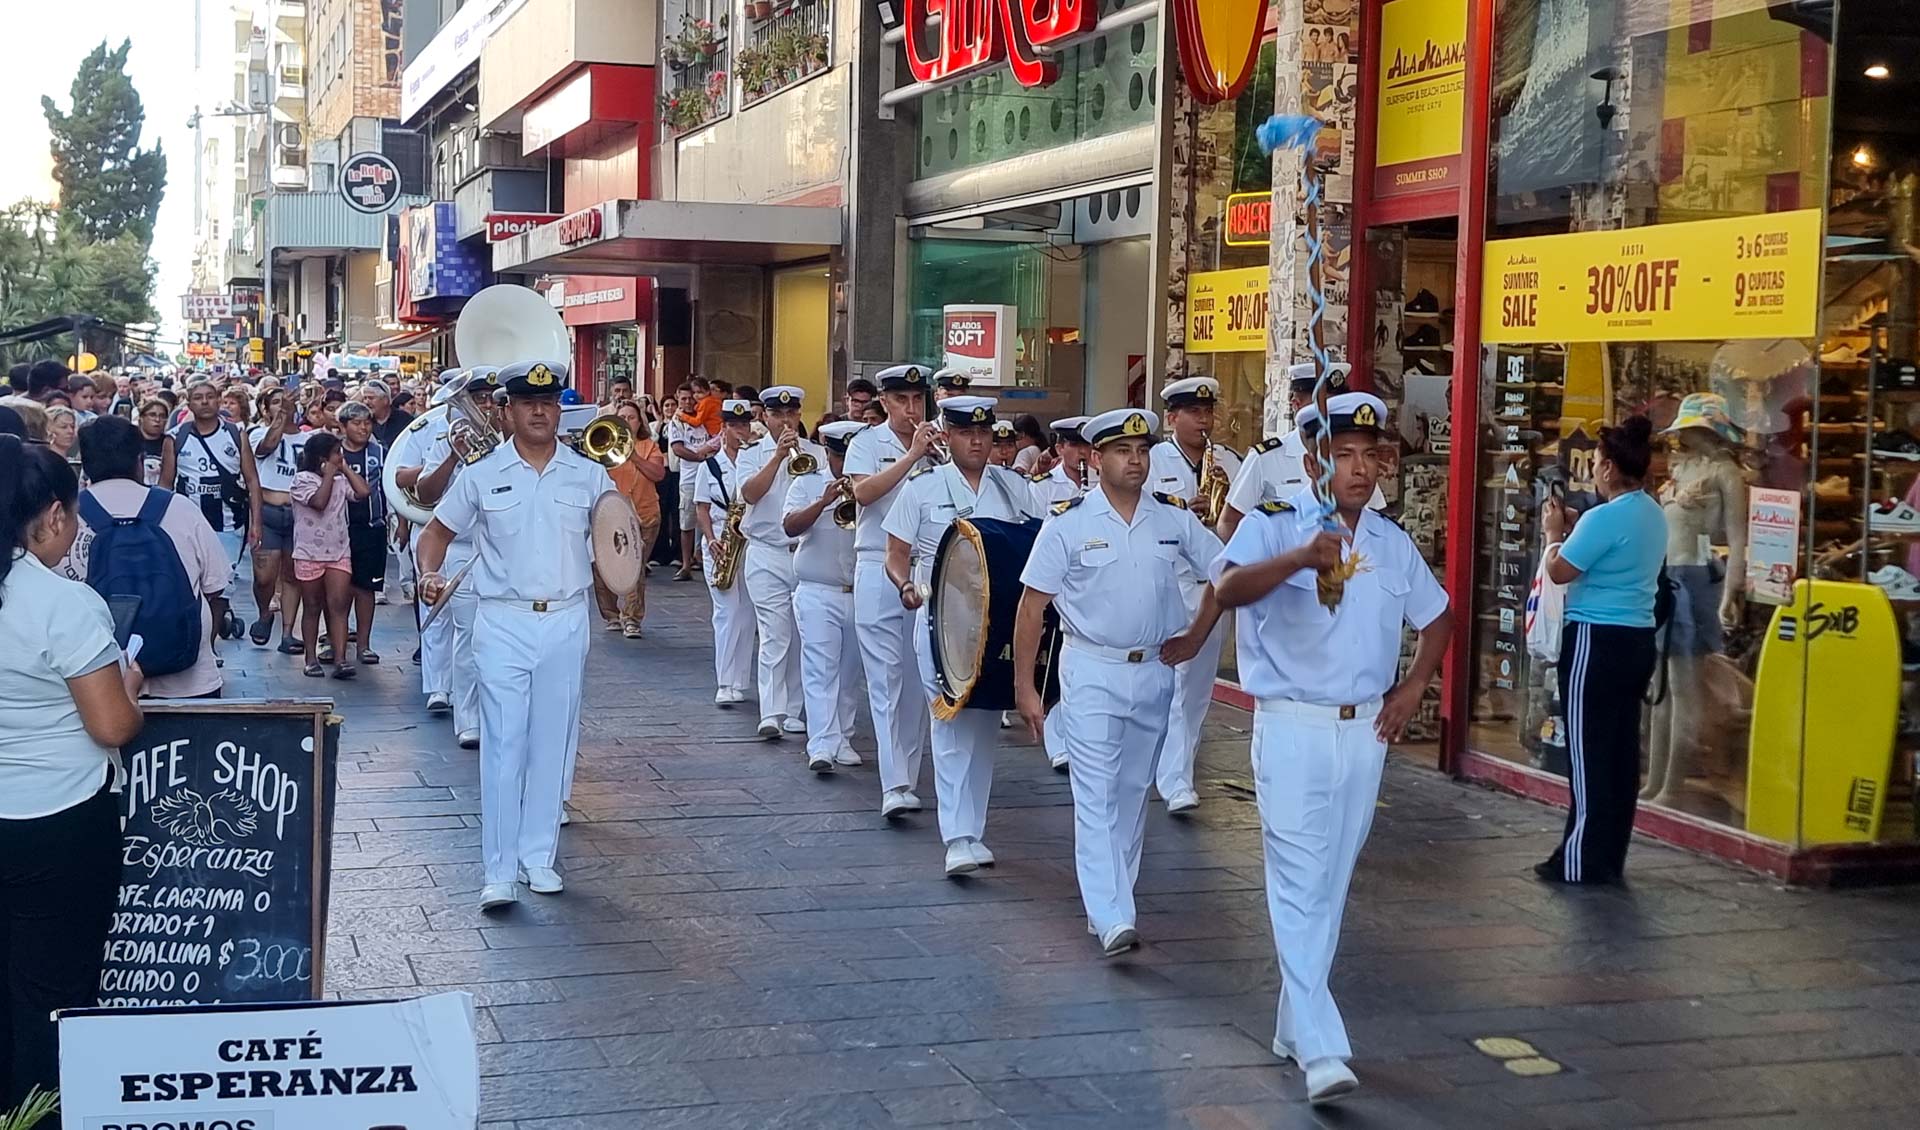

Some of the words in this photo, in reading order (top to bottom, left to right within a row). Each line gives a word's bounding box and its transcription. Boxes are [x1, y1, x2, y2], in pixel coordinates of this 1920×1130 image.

[1387, 47, 1416, 80] ALA
[1395, 171, 1426, 185] SUMMER
[1428, 166, 1448, 181] SHOP
[493, 220, 539, 236] plasti
[1736, 236, 1745, 259] 3
[1754, 233, 1762, 258] 6
[1503, 271, 1539, 290] SUMMER
[1735, 272, 1746, 307] 9
[1748, 271, 1785, 291] CUOTAS
[187, 297, 230, 306] HOTEL
[1502, 294, 1538, 328] SALE
[947, 329, 986, 346] SOFT
[951, 321, 982, 329] HELADOS
[1193, 315, 1215, 341] SALE
[124, 739, 190, 820] AFE
[213, 741, 298, 840] SHOP
[122, 835, 275, 878] Esperanza
[218, 938, 234, 970] $
[217, 1030, 323, 1063] CAFÉ
[120, 1065, 418, 1103] ESPERANZA
